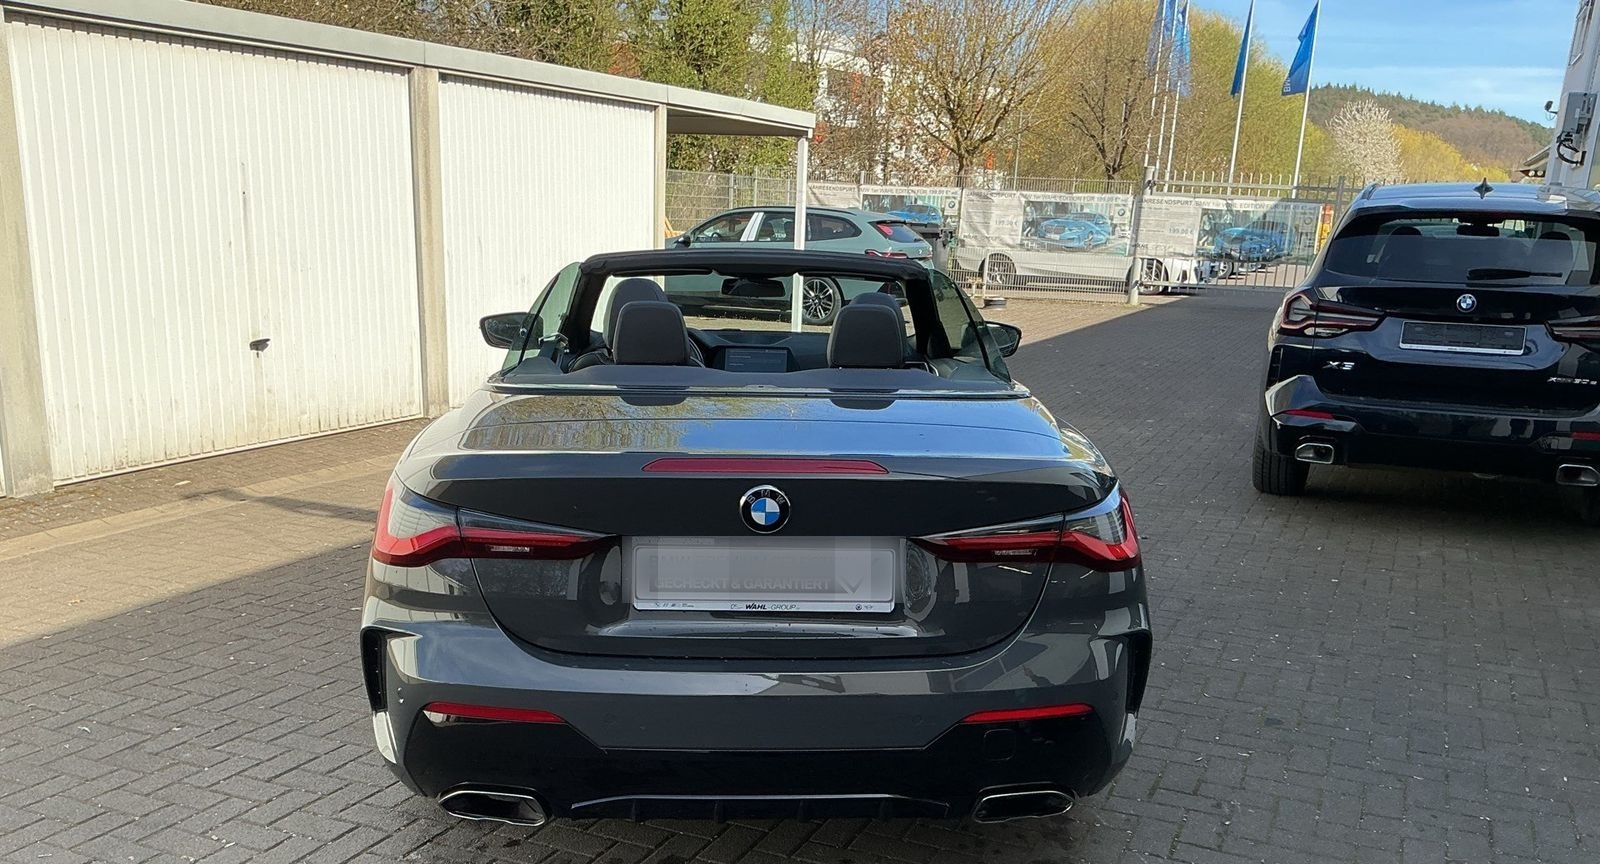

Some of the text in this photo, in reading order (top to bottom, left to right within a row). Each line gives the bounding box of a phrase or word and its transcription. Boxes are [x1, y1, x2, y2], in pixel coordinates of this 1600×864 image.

[746, 489, 786, 505] BMW
[655, 577, 730, 589] GECHECKT
[743, 578, 832, 590] GARANTIERT
